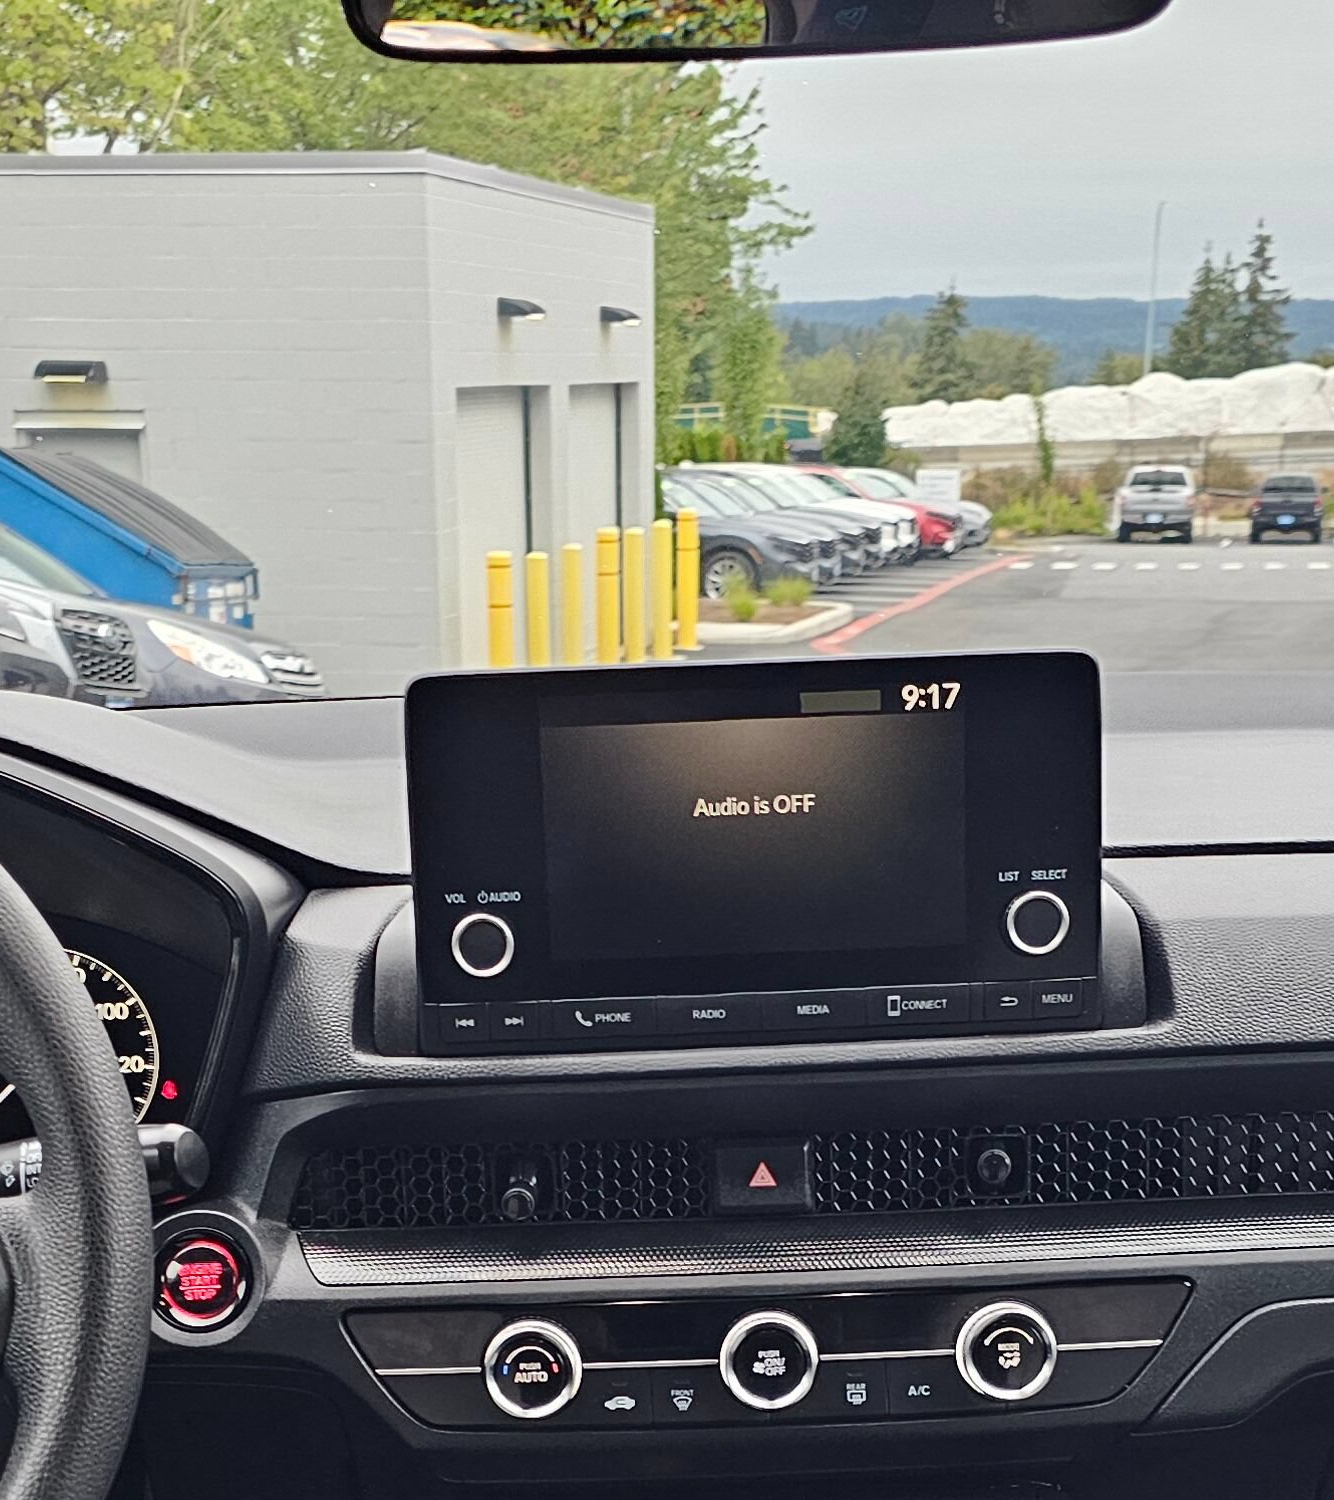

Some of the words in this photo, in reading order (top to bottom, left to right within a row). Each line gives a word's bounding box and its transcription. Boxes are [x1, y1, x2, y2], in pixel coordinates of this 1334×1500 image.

[901, 682, 961, 711] 9:17
[693, 798, 750, 817] Audio
[753, 795, 770, 815] is
[772, 793, 816, 814] OFF
[998, 871, 1020, 882] LIST
[1030, 868, 1068, 880] SELECT
[444, 893, 467, 904] VOL
[489, 891, 522, 902] AUDIO
[1041, 994, 1073, 1004] MENU
[797, 1005, 830, 1015] MEDIA
[901, 999, 948, 1011] CONNECT
[94, 1003, 130, 1021] 100
[595, 1012, 631, 1023] PHONE
[692, 1009, 726, 1020] RADIO
[180, 1275, 220, 1286] START
[184, 1289, 217, 1300] STOP
[765, 1366, 786, 1376] OFF
[514, 1370, 549, 1384] AUTO
[671, 1389, 694, 1397] FRONT
[908, 1385, 931, 1396] A/C
